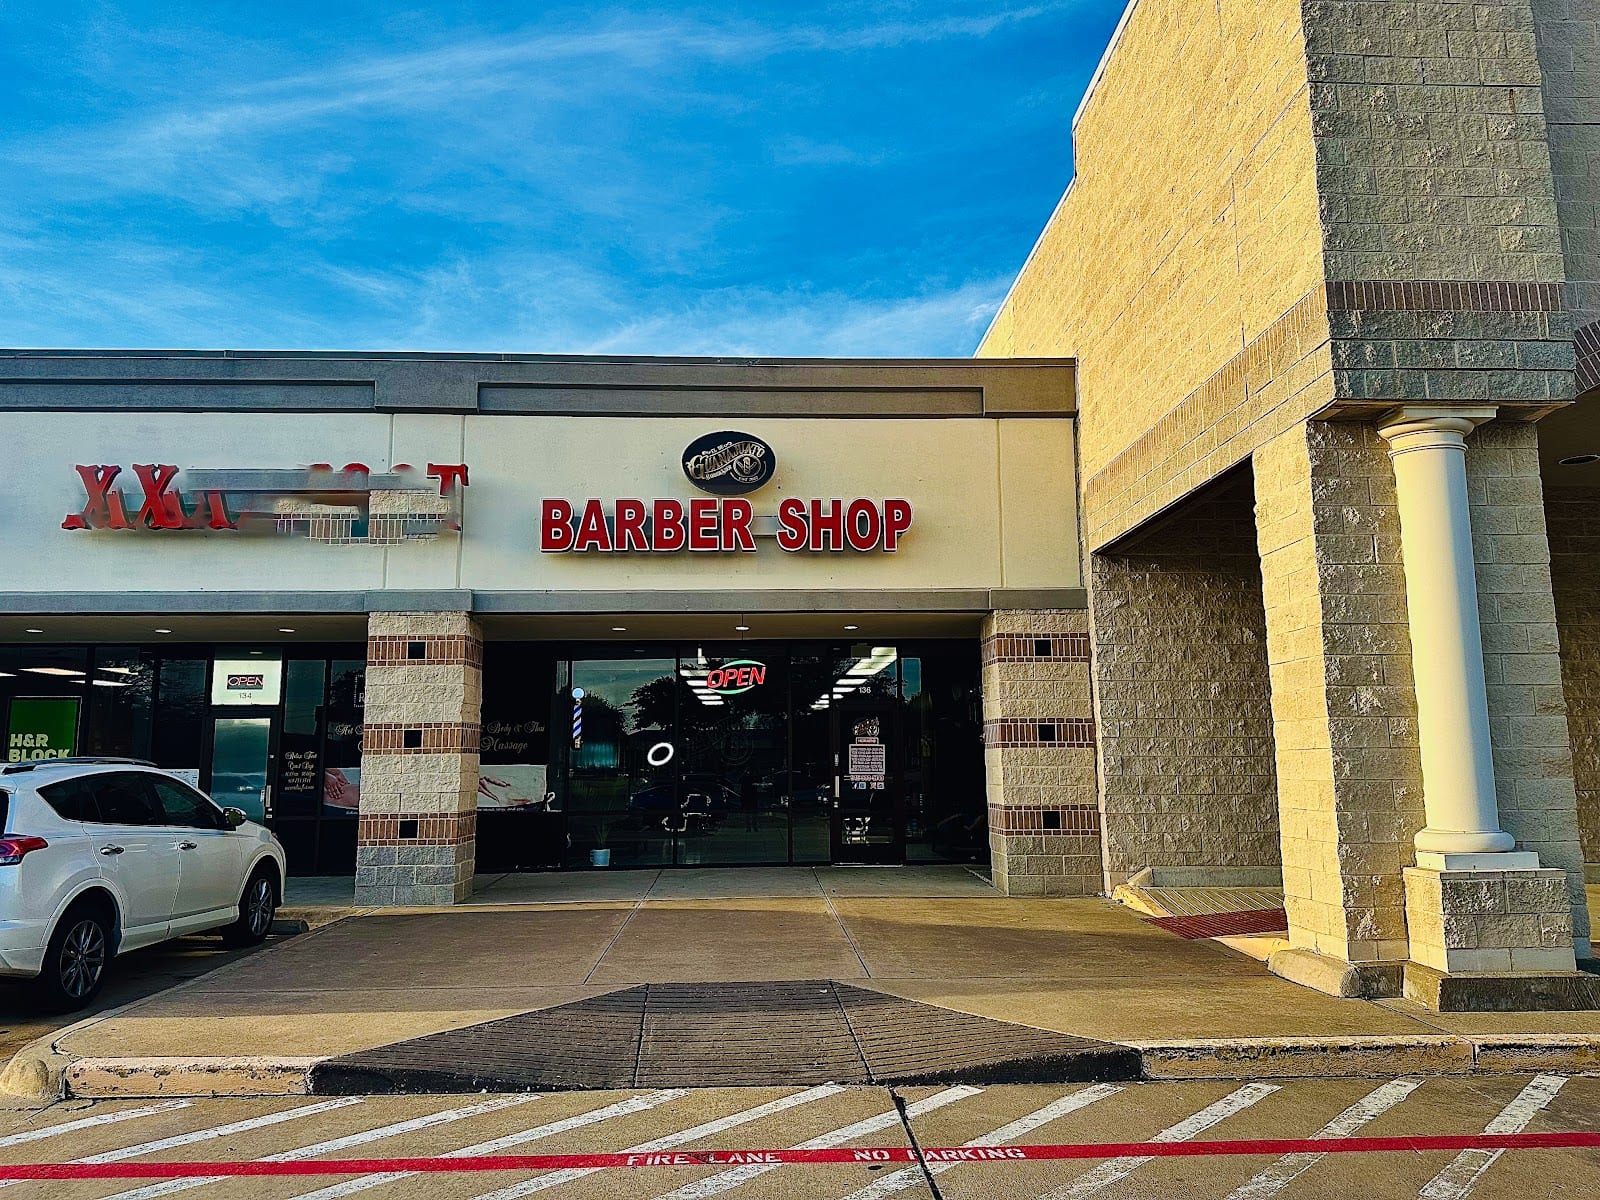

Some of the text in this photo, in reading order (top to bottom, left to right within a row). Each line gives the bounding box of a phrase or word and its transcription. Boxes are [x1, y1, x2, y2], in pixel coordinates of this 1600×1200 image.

[685, 441, 765, 480] GUANAJUATO
[540, 498, 913, 553] BARBER SHOP
[228, 676, 263, 686] OPEN
[707, 665, 766, 689] OPEN
[859, 686, 871, 694] 136
[10, 733, 49, 748] H&R
[480, 736, 528, 753] Massage
[9, 748, 70, 763] BLOCK
[626, 1152, 783, 1166] FIRE LANE
[853, 1148, 1027, 1161] NO PARKING
